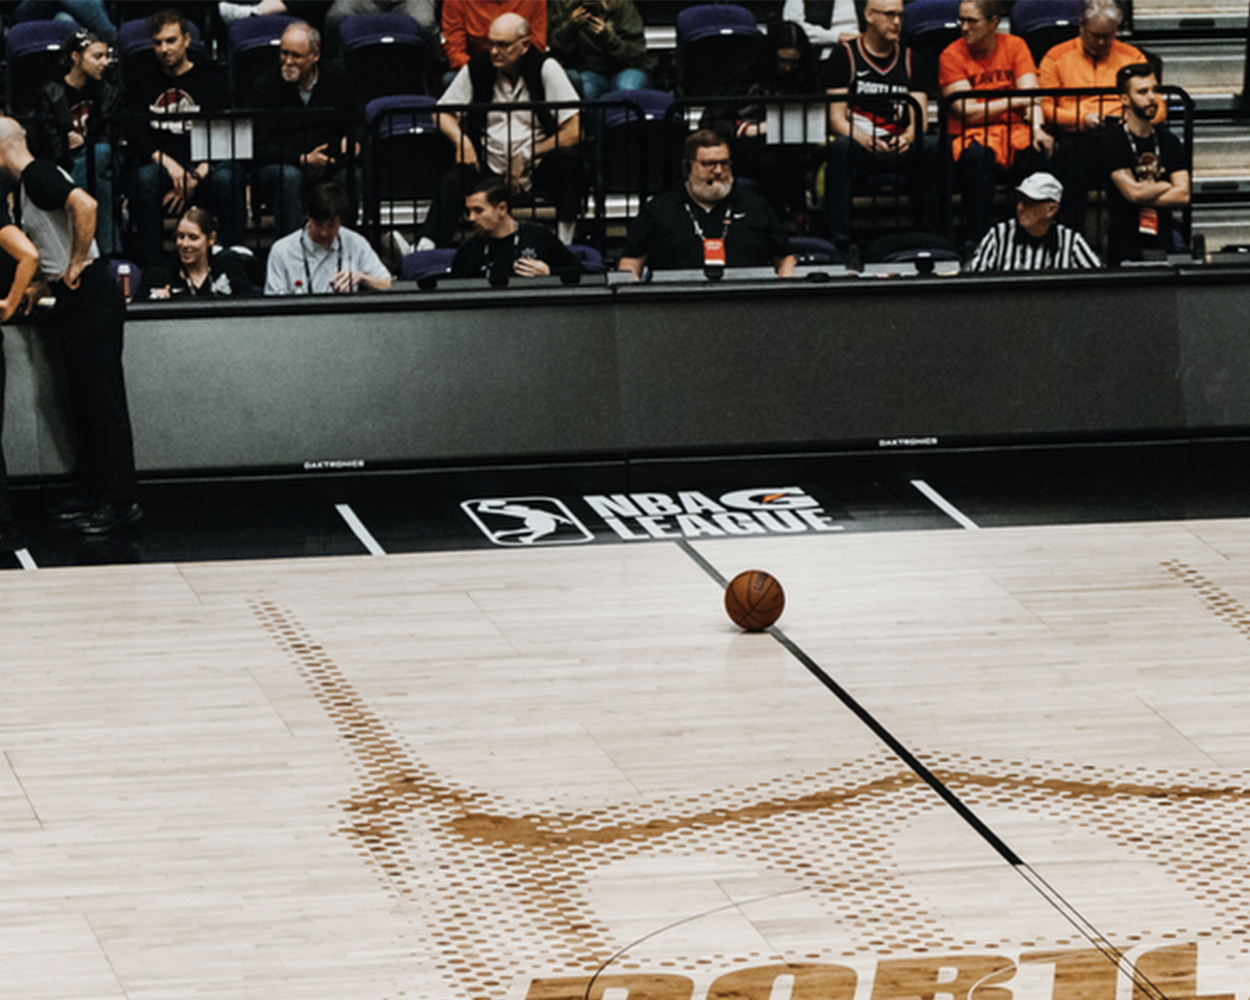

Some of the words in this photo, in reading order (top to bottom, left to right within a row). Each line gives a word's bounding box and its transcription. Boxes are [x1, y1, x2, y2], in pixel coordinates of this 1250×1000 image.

[879, 437, 938, 447] DAKTRONICS
[303, 460, 365, 470] DAKTRONICS
[583, 491, 727, 518] NBA
[604, 508, 845, 540] LEAGUE
